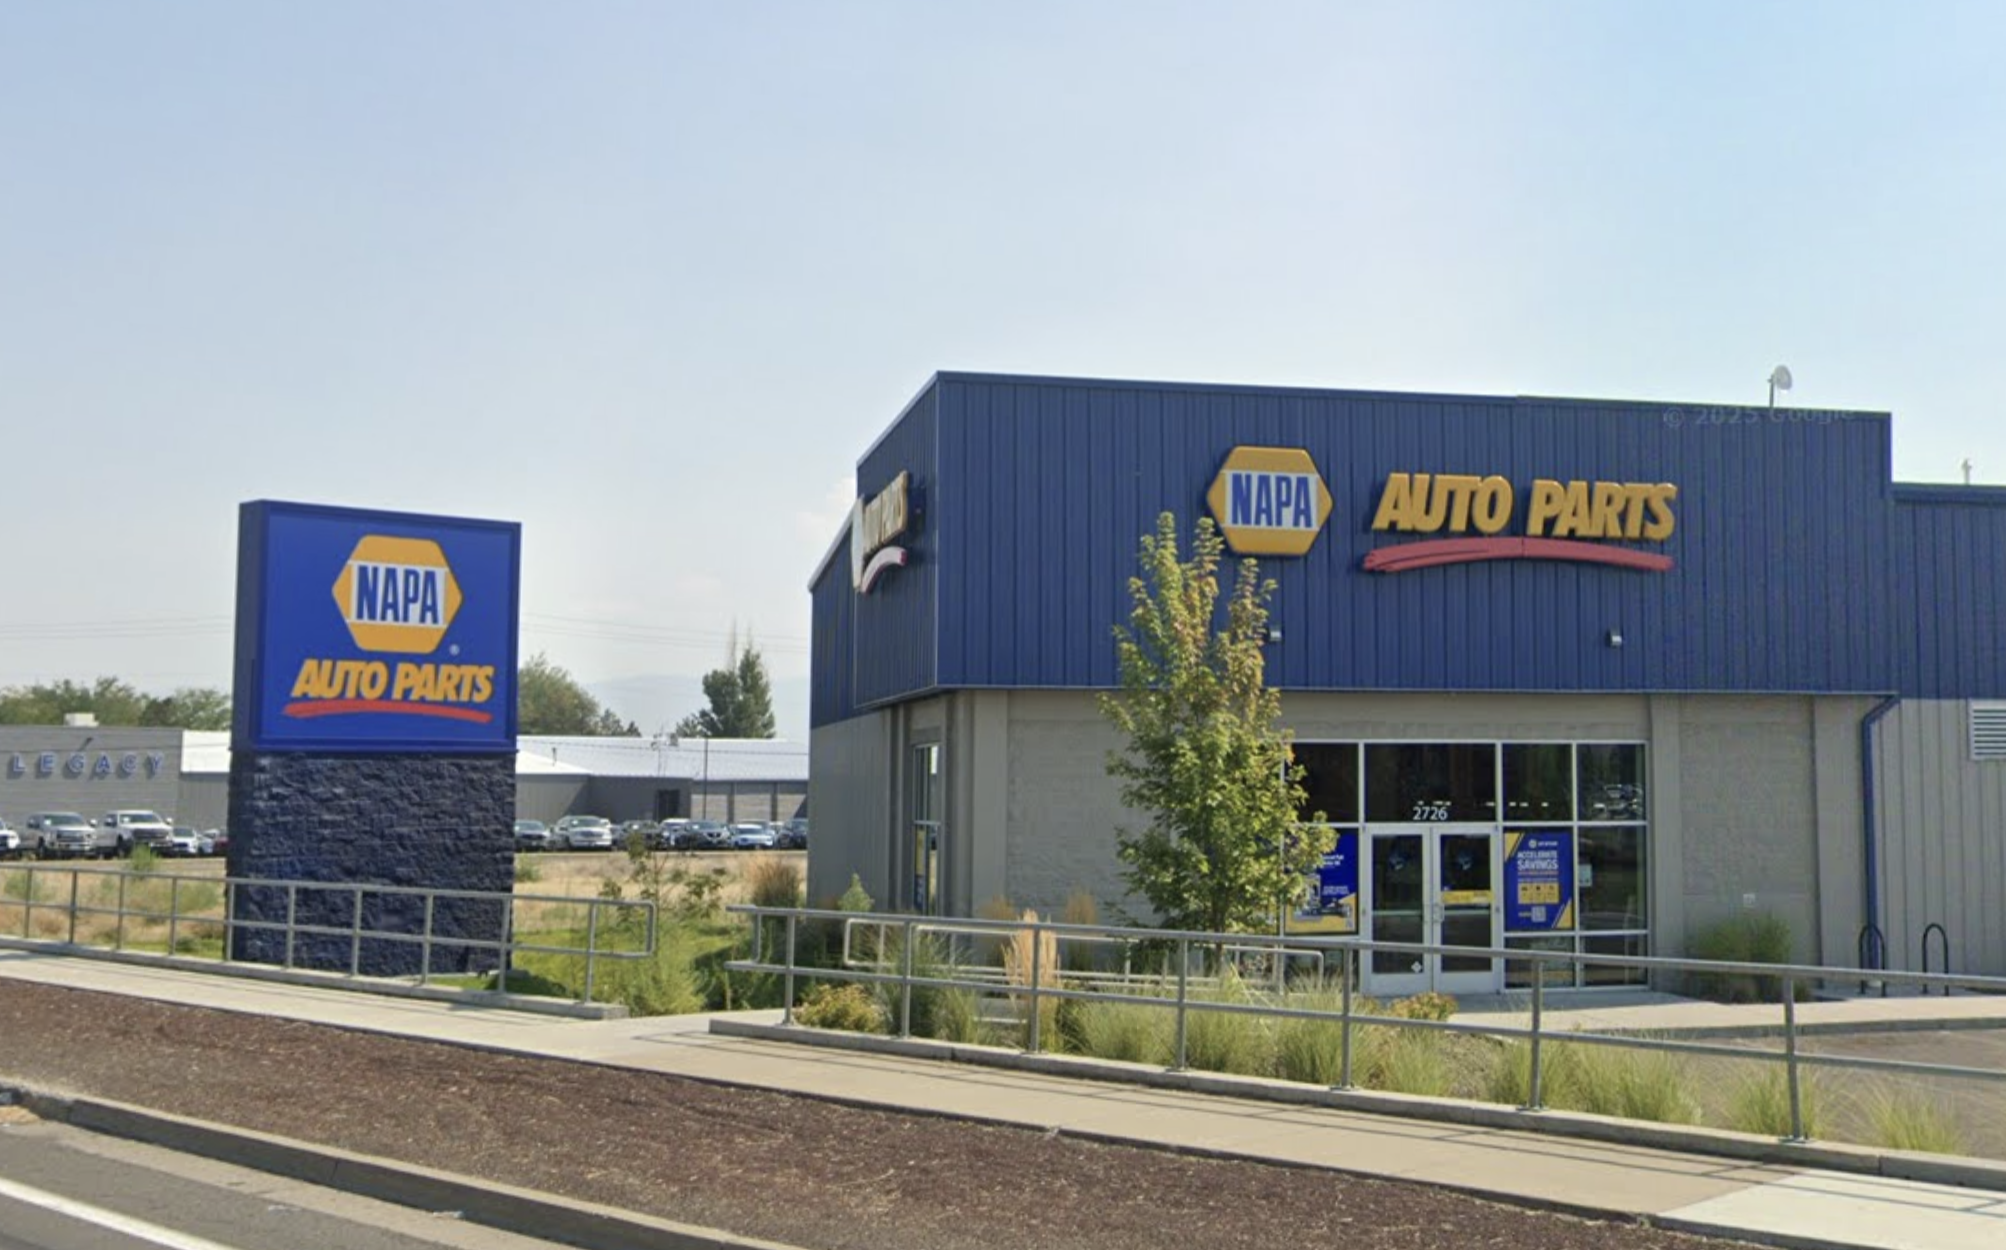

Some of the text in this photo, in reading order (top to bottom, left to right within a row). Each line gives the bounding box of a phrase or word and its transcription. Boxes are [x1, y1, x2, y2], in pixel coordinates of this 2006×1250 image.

[1231, 472, 1313, 528] NAPA
[1371, 472, 1678, 541] AUTO PARTS
[356, 564, 439, 625] NAPA
[291, 659, 495, 703] AUTO PARTS
[11, 751, 164, 774] LEGACY
[1412, 806, 1448, 820] 2726
[1517, 859, 1559, 870] SAVINGS
